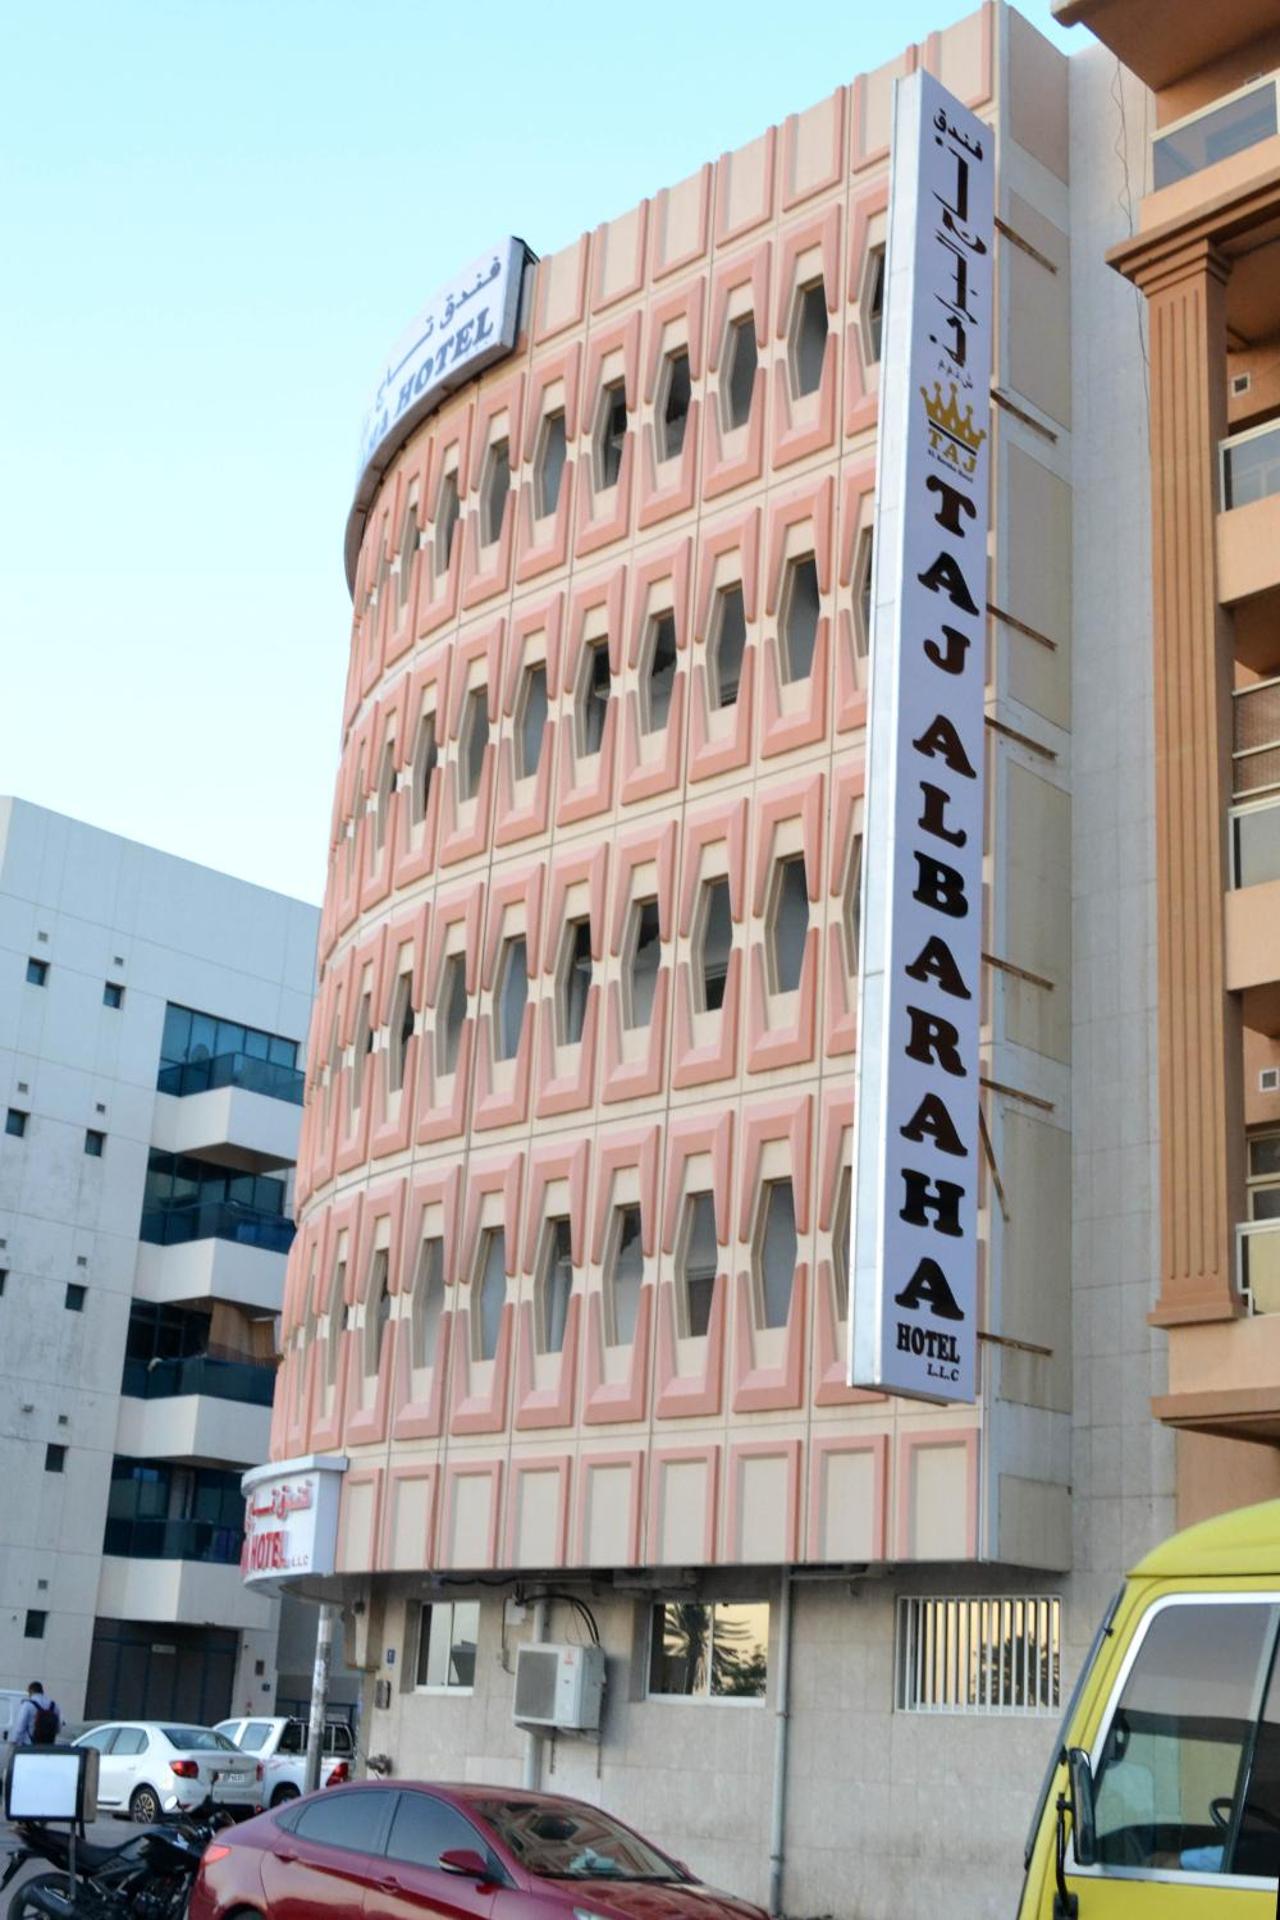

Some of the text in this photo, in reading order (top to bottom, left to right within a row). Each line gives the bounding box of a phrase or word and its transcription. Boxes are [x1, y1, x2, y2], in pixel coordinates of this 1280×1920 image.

[932, 106, 984, 162] فندق
[440, 255, 502, 330] فندق
[396, 307, 494, 418] HOTEL
[928, 427, 977, 473] TAJ
[917, 474, 979, 675] TAJ
[894, 714, 977, 1321] ALBARAHA
[896, 1322, 961, 1364] HOTEL
